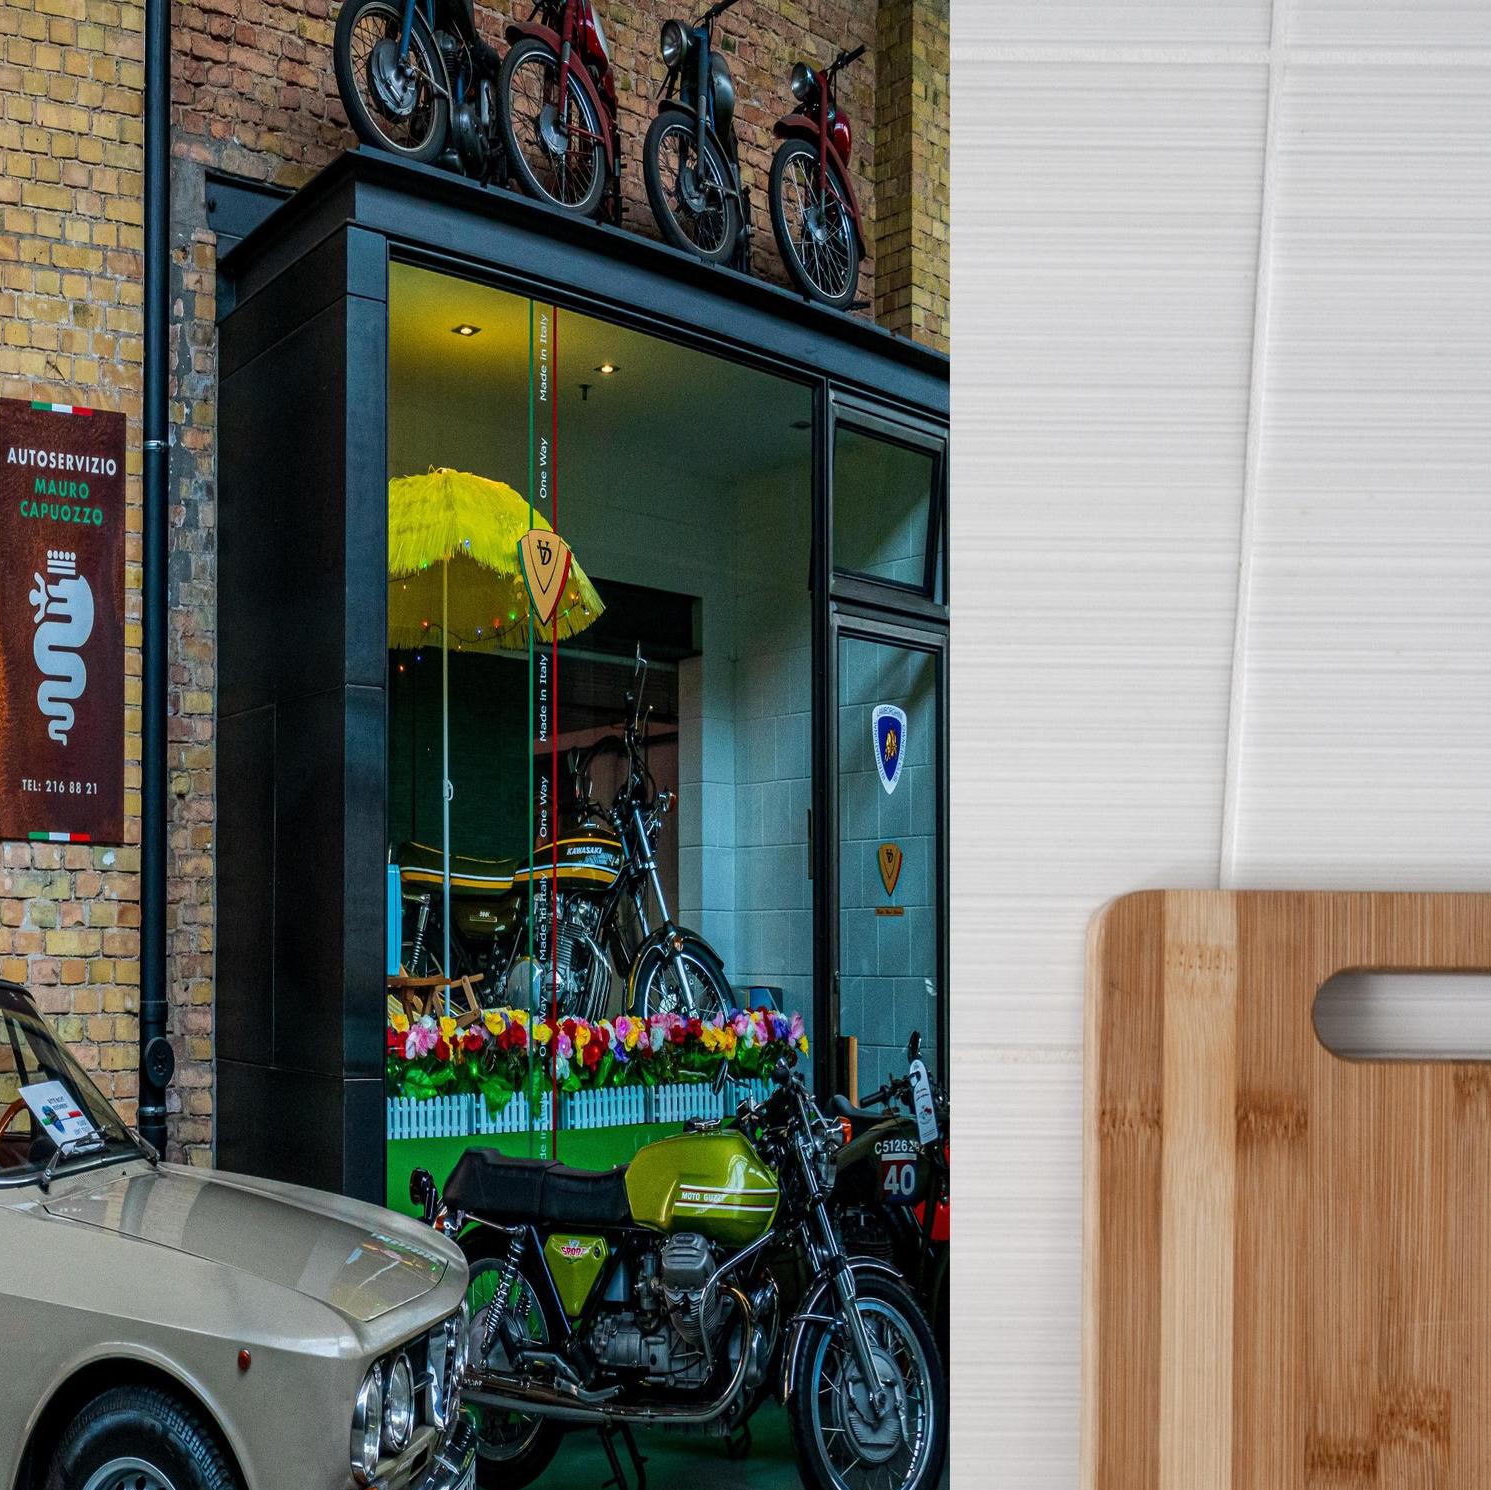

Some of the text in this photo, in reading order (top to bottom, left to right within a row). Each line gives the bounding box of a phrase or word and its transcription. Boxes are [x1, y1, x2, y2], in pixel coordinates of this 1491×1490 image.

[539, 313, 548, 401] Made in Italy
[7, 447, 117, 476] AUTOSERVIZIO
[539, 437, 548, 499] One Way
[35, 478, 90, 499] MAURO
[20, 500, 104, 527] CAPUOZZO
[539, 654, 548, 742] Made in Italy
[22, 779, 98, 795] TEL: 216 88 21
[539, 776, 548, 838] One Way
[566, 846, 603, 856] KAWASAKI
[539, 924, 547, 961] Made
[539, 1143, 547, 1160] de
[883, 1164, 916, 1196] 40
[682, 1191, 700, 1201] MOTO
